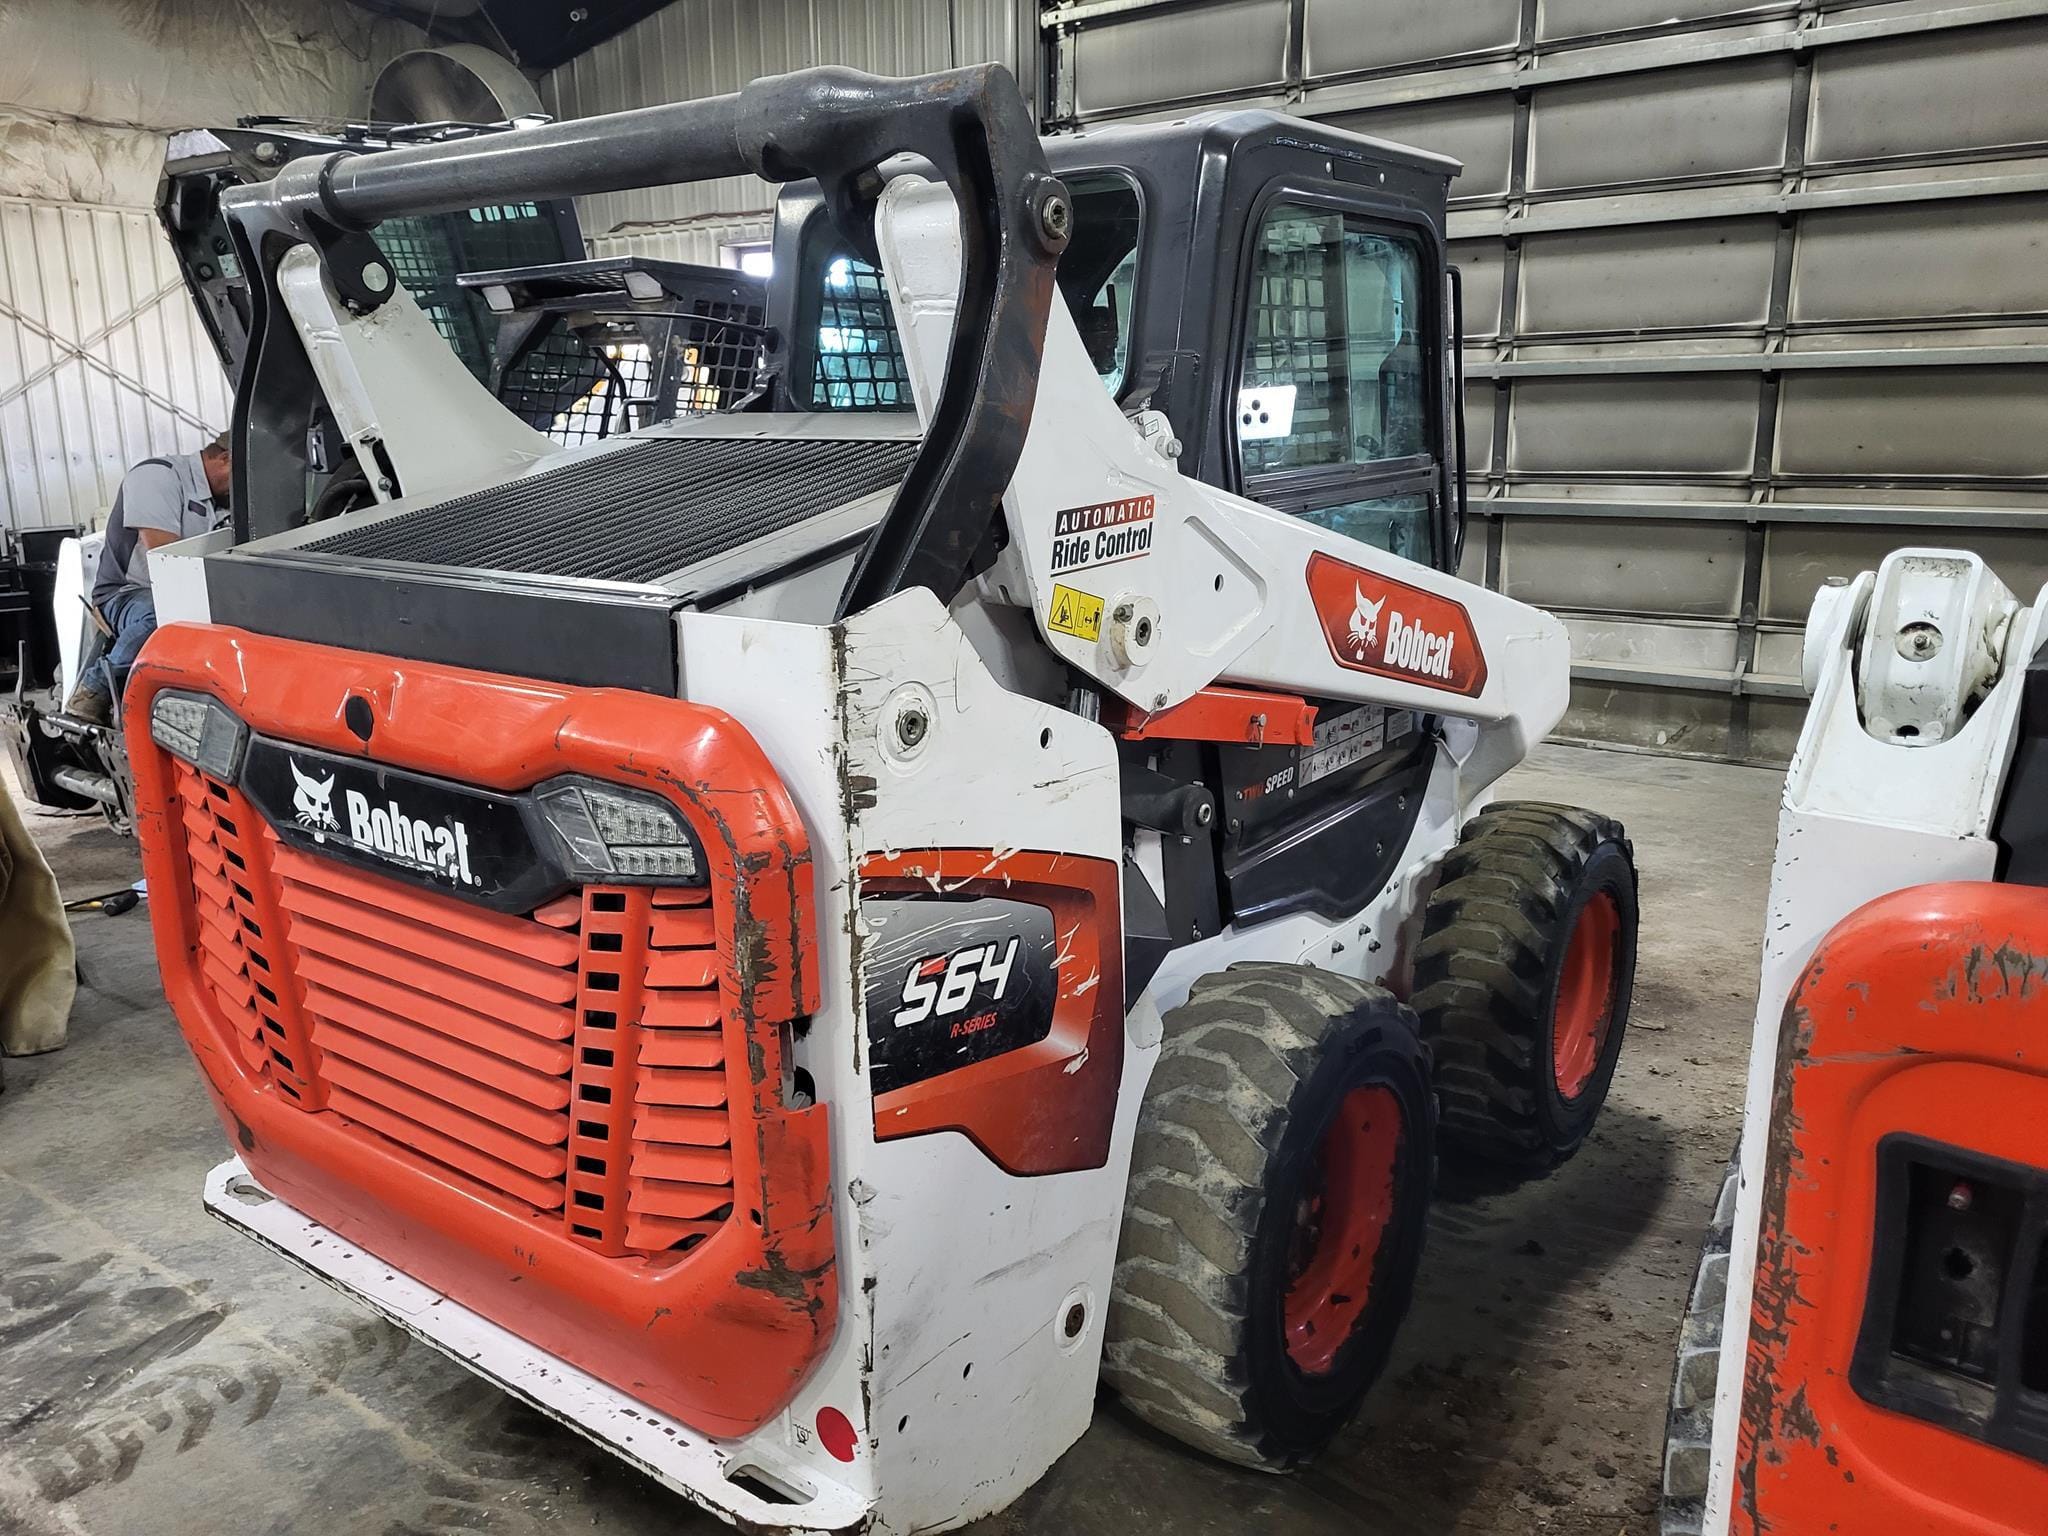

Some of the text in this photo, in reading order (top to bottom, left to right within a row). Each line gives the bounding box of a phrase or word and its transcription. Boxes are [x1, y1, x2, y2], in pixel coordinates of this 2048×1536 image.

[1058, 499, 1152, 533] AUTOMATIC
[1051, 521, 1153, 570] Ride Control
[1383, 611, 1455, 680] Bobcat
[1265, 766, 1294, 794] SPEED
[346, 789, 473, 885] Bobcat
[894, 938, 1020, 1028] S64
[951, 1012, 999, 1038] R-SERIES
